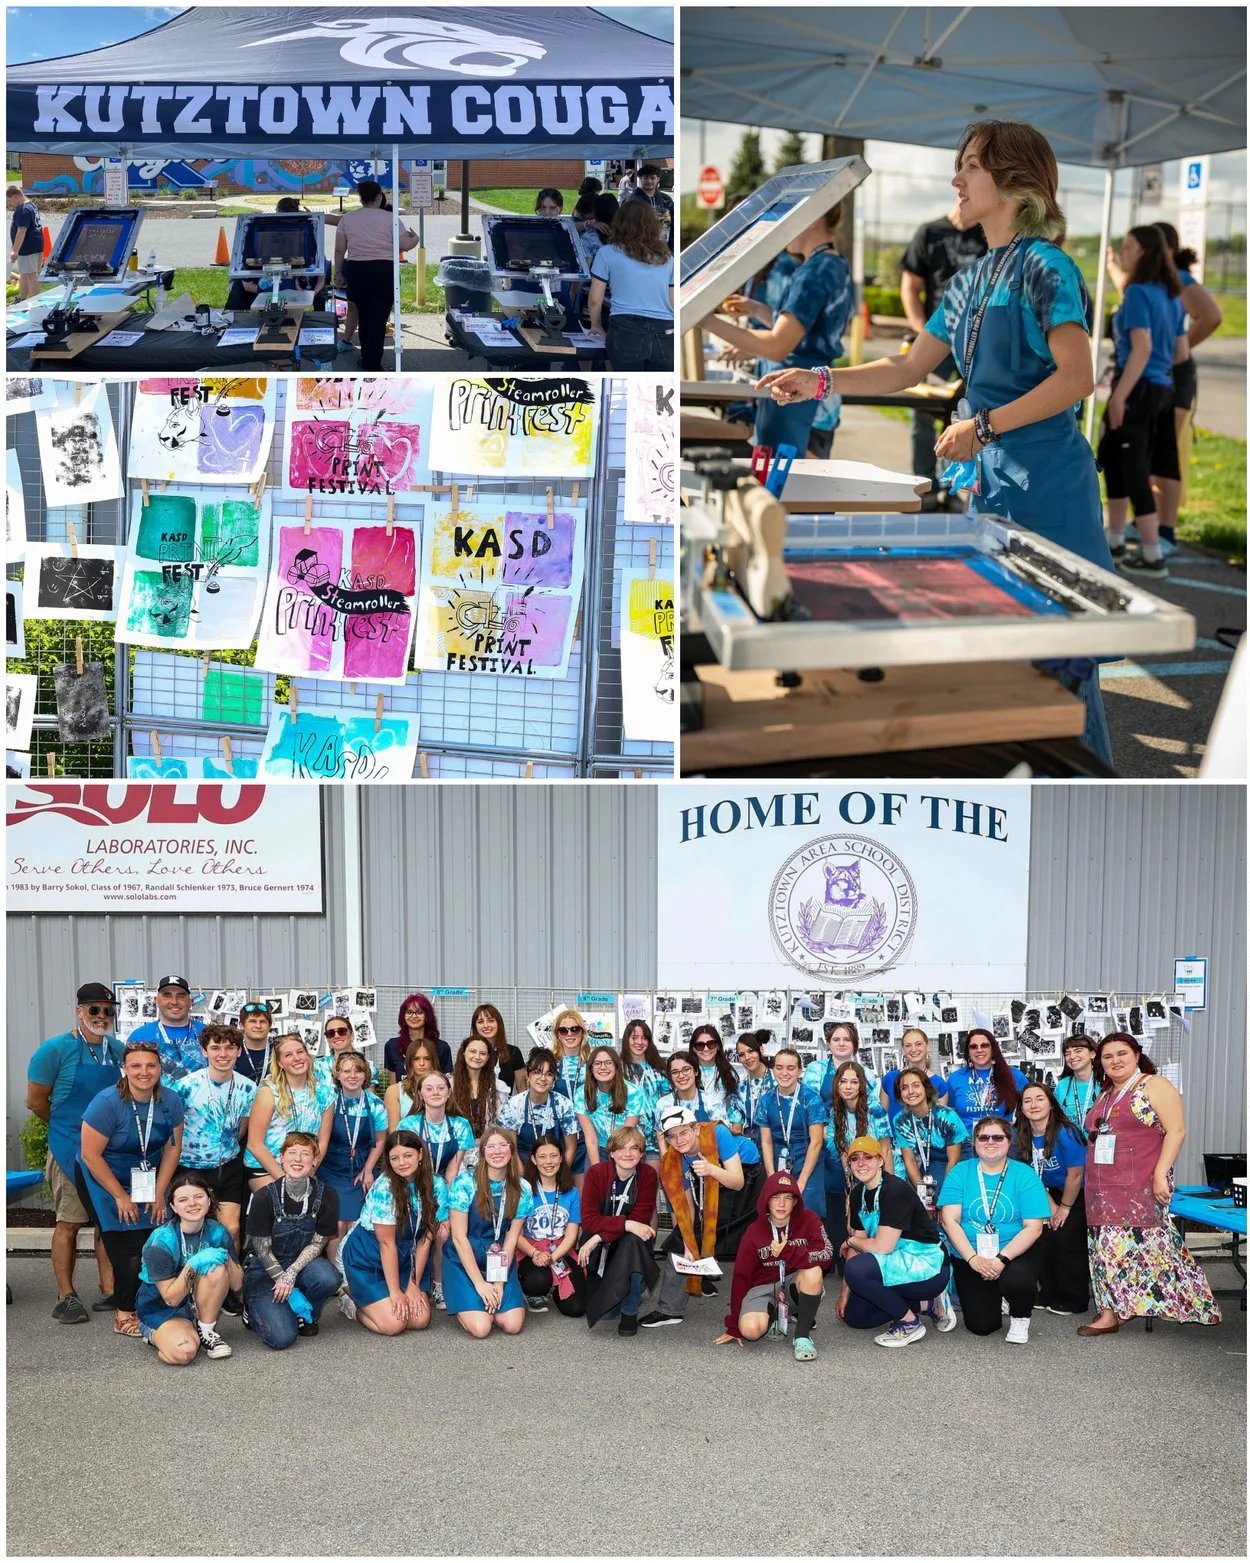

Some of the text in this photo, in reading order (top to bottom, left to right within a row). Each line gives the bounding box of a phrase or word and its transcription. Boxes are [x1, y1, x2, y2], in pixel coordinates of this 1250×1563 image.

[33, 85, 432, 135] KUTZTOWN
[170, 385, 214, 406] FEST
[332, 457, 386, 478] PRINT
[160, 533, 189, 543] KASD
[454, 526, 553, 561] KASD
[158, 536, 223, 564] PRINT
[162, 563, 205, 584] FEST
[338, 568, 387, 590] KASD
[320, 585, 401, 610] Steamroller
[475, 633, 532, 657] PRINT
[679, 791, 1009, 843] HOME OF THE
[86, 839, 258, 857] LABORATORIES, INC.
[10, 858, 66, 875] Serve
[146, 858, 195, 875] Love
[201, 858, 268, 875] Others
[30, 884, 40, 892] by
[42, 884, 64, 892] Barry
[66, 883, 89, 892] Sokol,
[91, 883, 111, 891] Class
[113, 883, 121, 891] of
[123, 884, 142, 892] 1967,
[145, 883, 174, 891] Randall
[176, 883, 215, 891] Schlenker
[218, 884, 238, 892] 1973,
[775, 840, 911, 955] KUTZTOWN AREA SCHOOL DISTRICT
